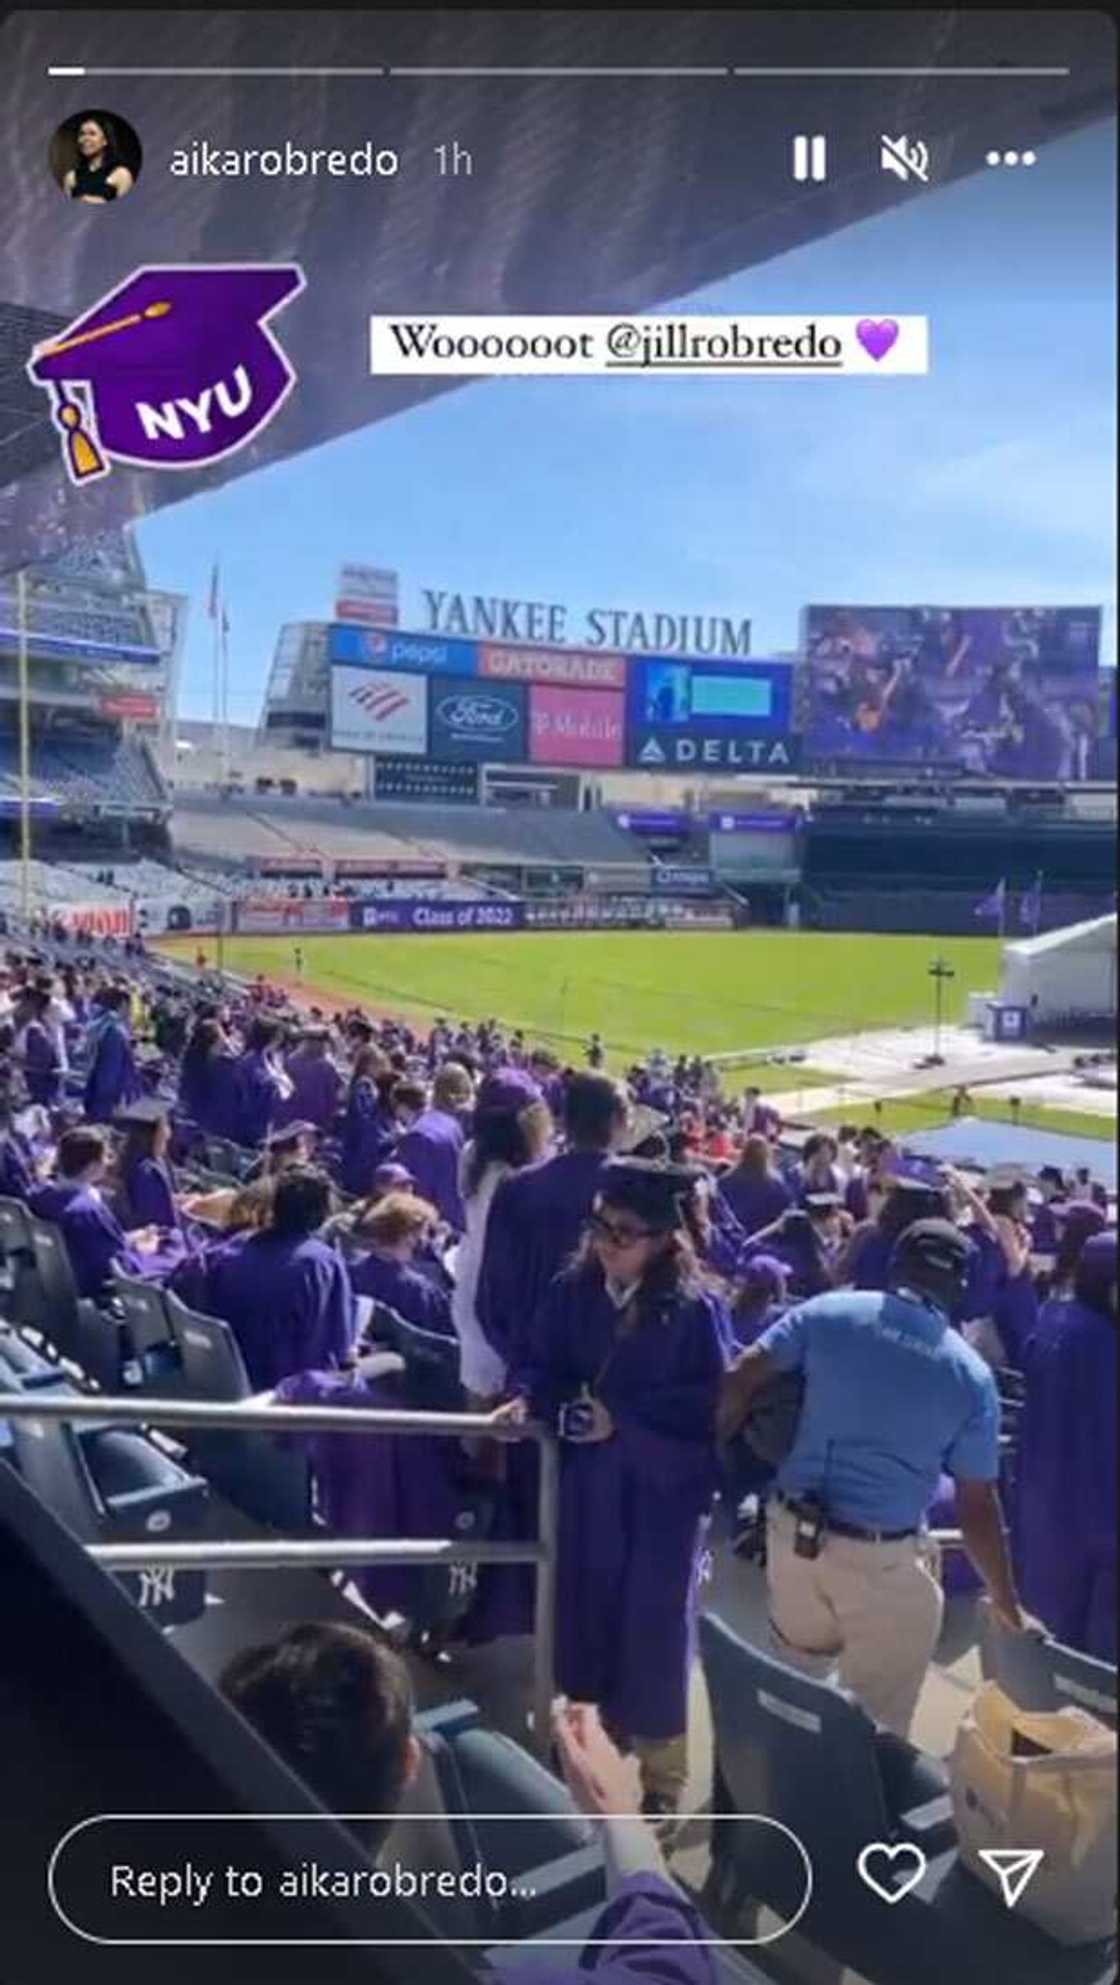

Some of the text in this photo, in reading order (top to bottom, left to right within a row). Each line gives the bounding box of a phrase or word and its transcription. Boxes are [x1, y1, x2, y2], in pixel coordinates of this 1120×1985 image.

[422, 589, 752, 657] YANKEE STADIUM
[676, 738, 790, 764] DELTA
[412, 907, 454, 926] Class
[457, 906, 475, 926] of
